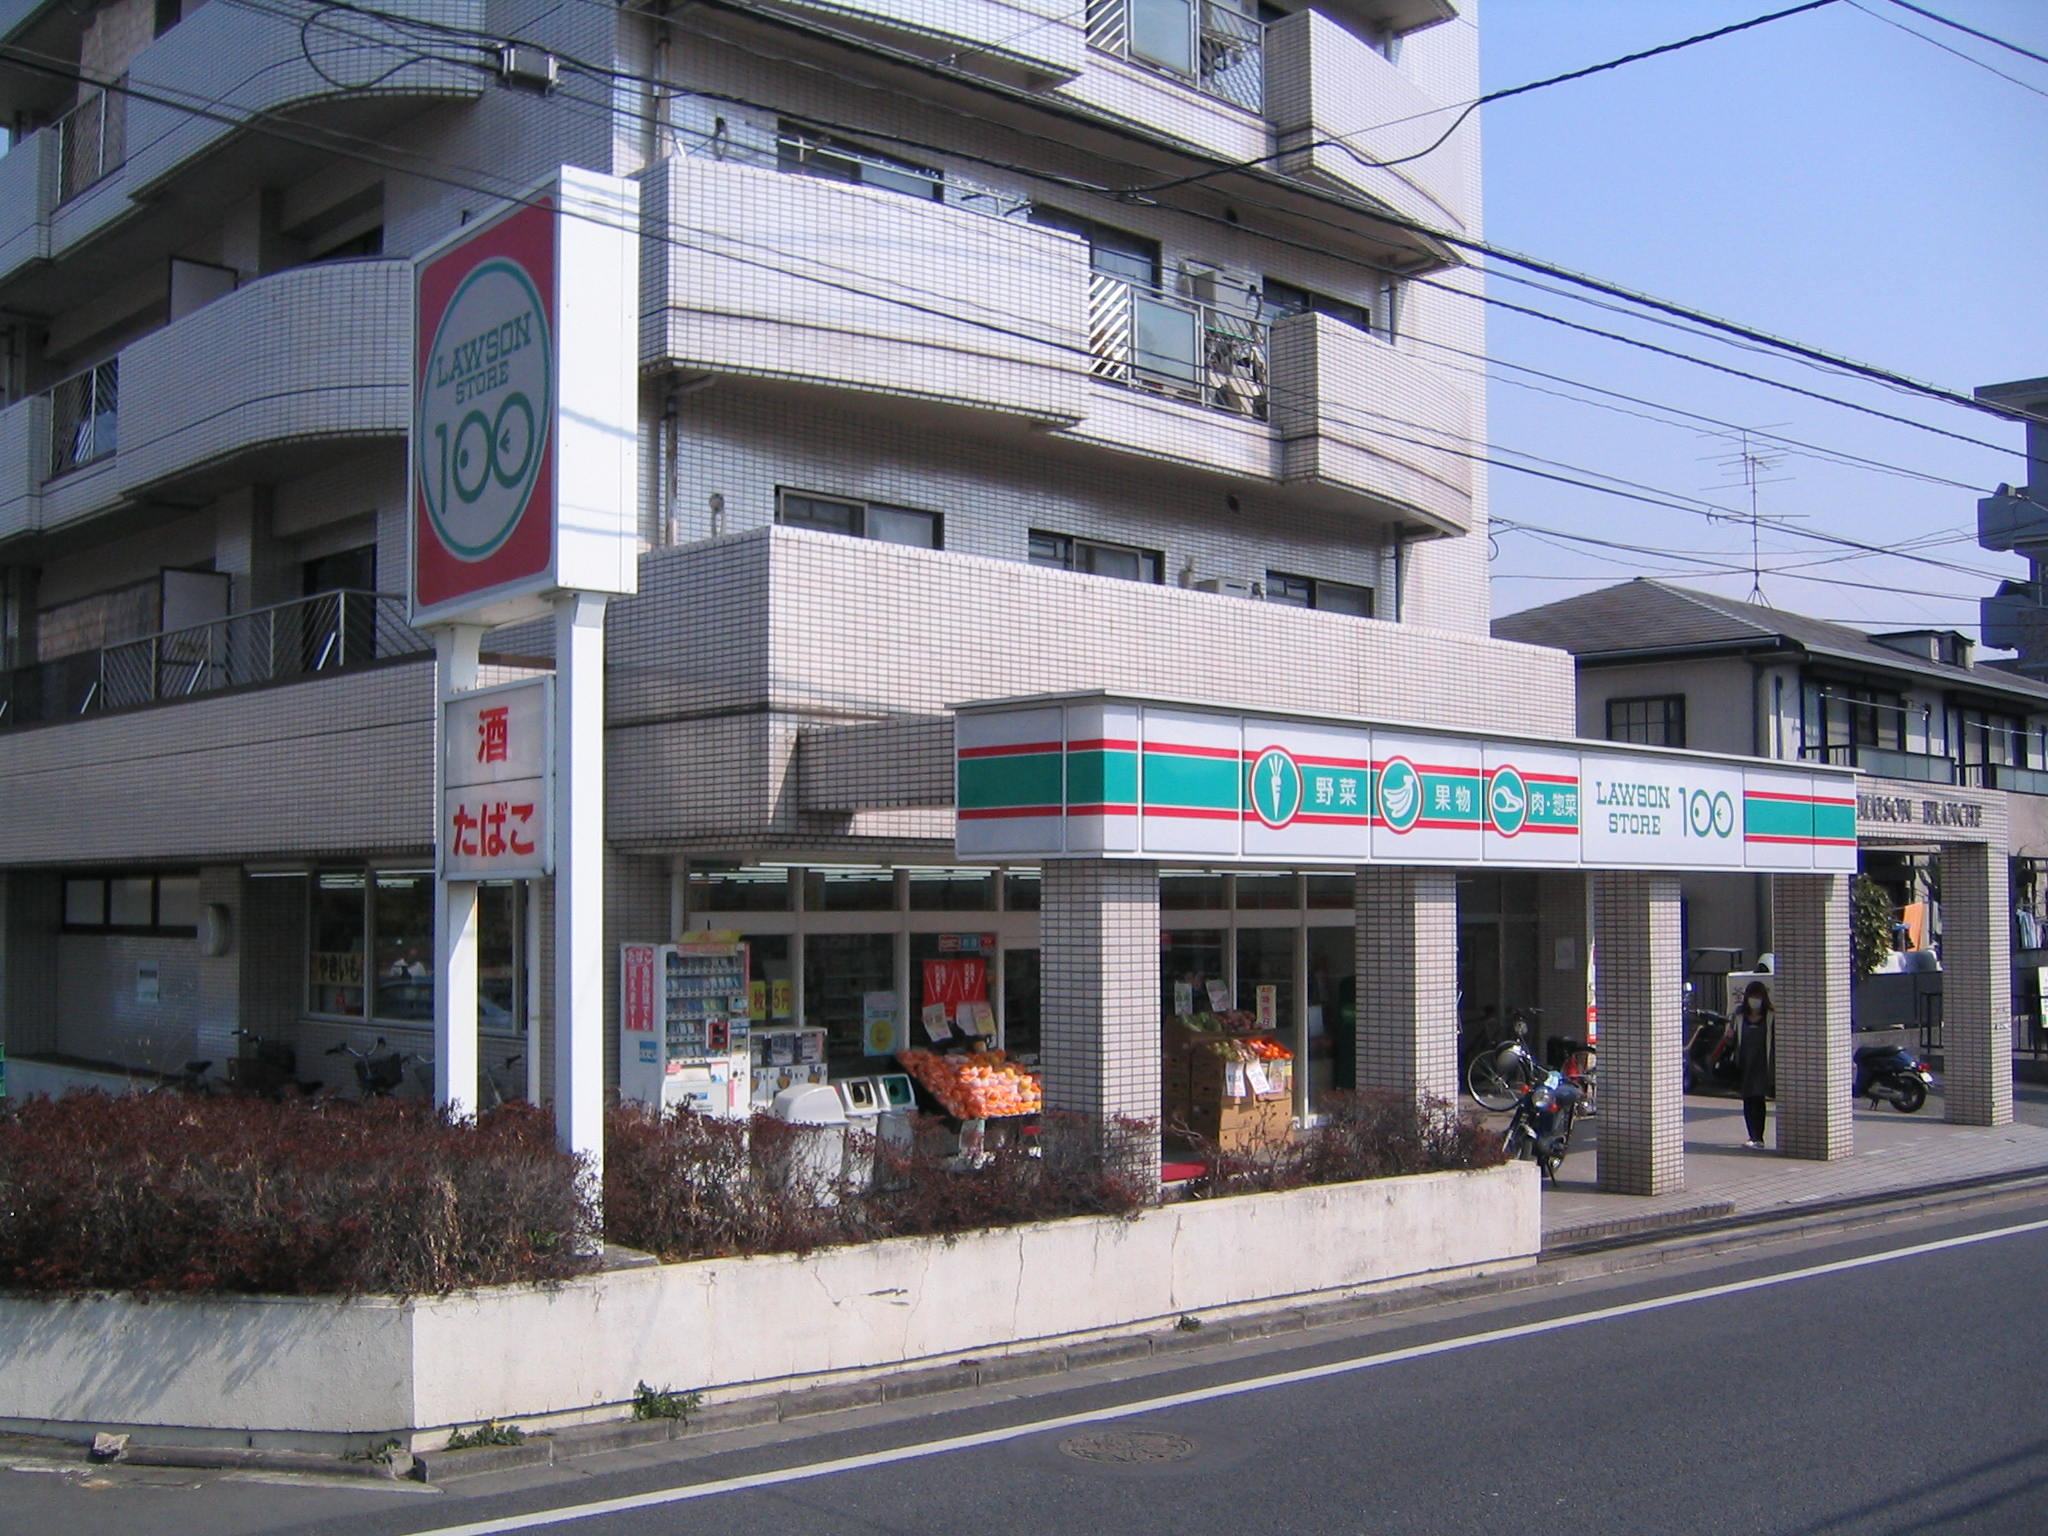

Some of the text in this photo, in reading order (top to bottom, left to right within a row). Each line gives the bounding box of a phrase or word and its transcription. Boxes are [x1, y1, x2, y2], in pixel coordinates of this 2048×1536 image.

[436, 311, 532, 389] LAWSON
[455, 359, 509, 405] STORE
[435, 392, 535, 514] 100
[478, 705, 509, 764] 酒
[1315, 776, 1358, 806] 野菜
[1434, 784, 1471, 812] 果物
[1596, 781, 1671, 809] LAWSON
[1678, 787, 1734, 839] 100
[453, 801, 535, 857] たばこ
[1608, 812, 1661, 836] STORE
